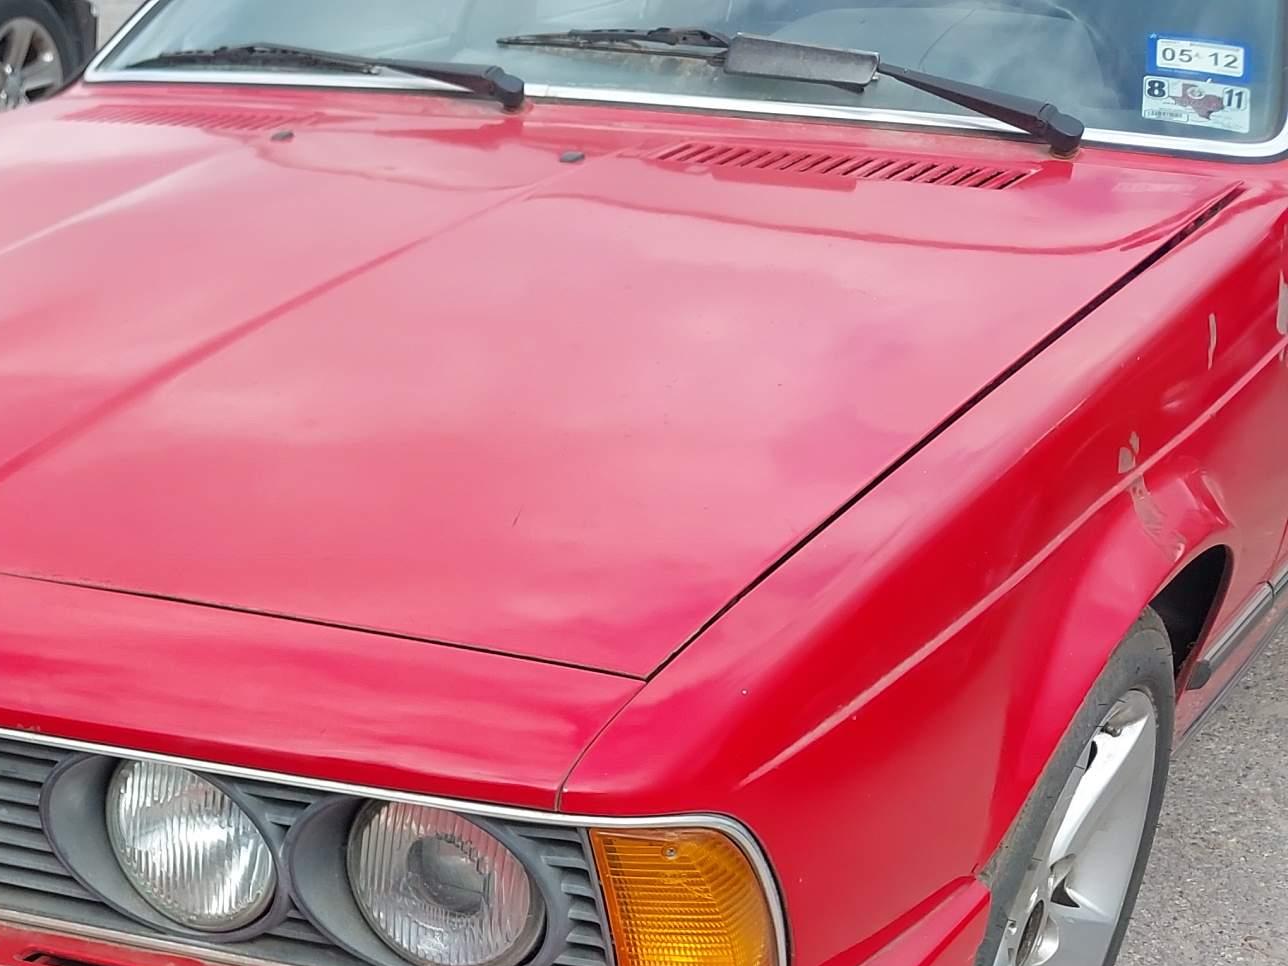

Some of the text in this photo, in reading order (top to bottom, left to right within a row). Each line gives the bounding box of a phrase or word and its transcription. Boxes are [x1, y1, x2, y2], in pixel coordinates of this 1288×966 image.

[1162, 47, 1193, 63] 05
[1209, 52, 1239, 69] 12
[1147, 80, 1244, 109] 8 11
